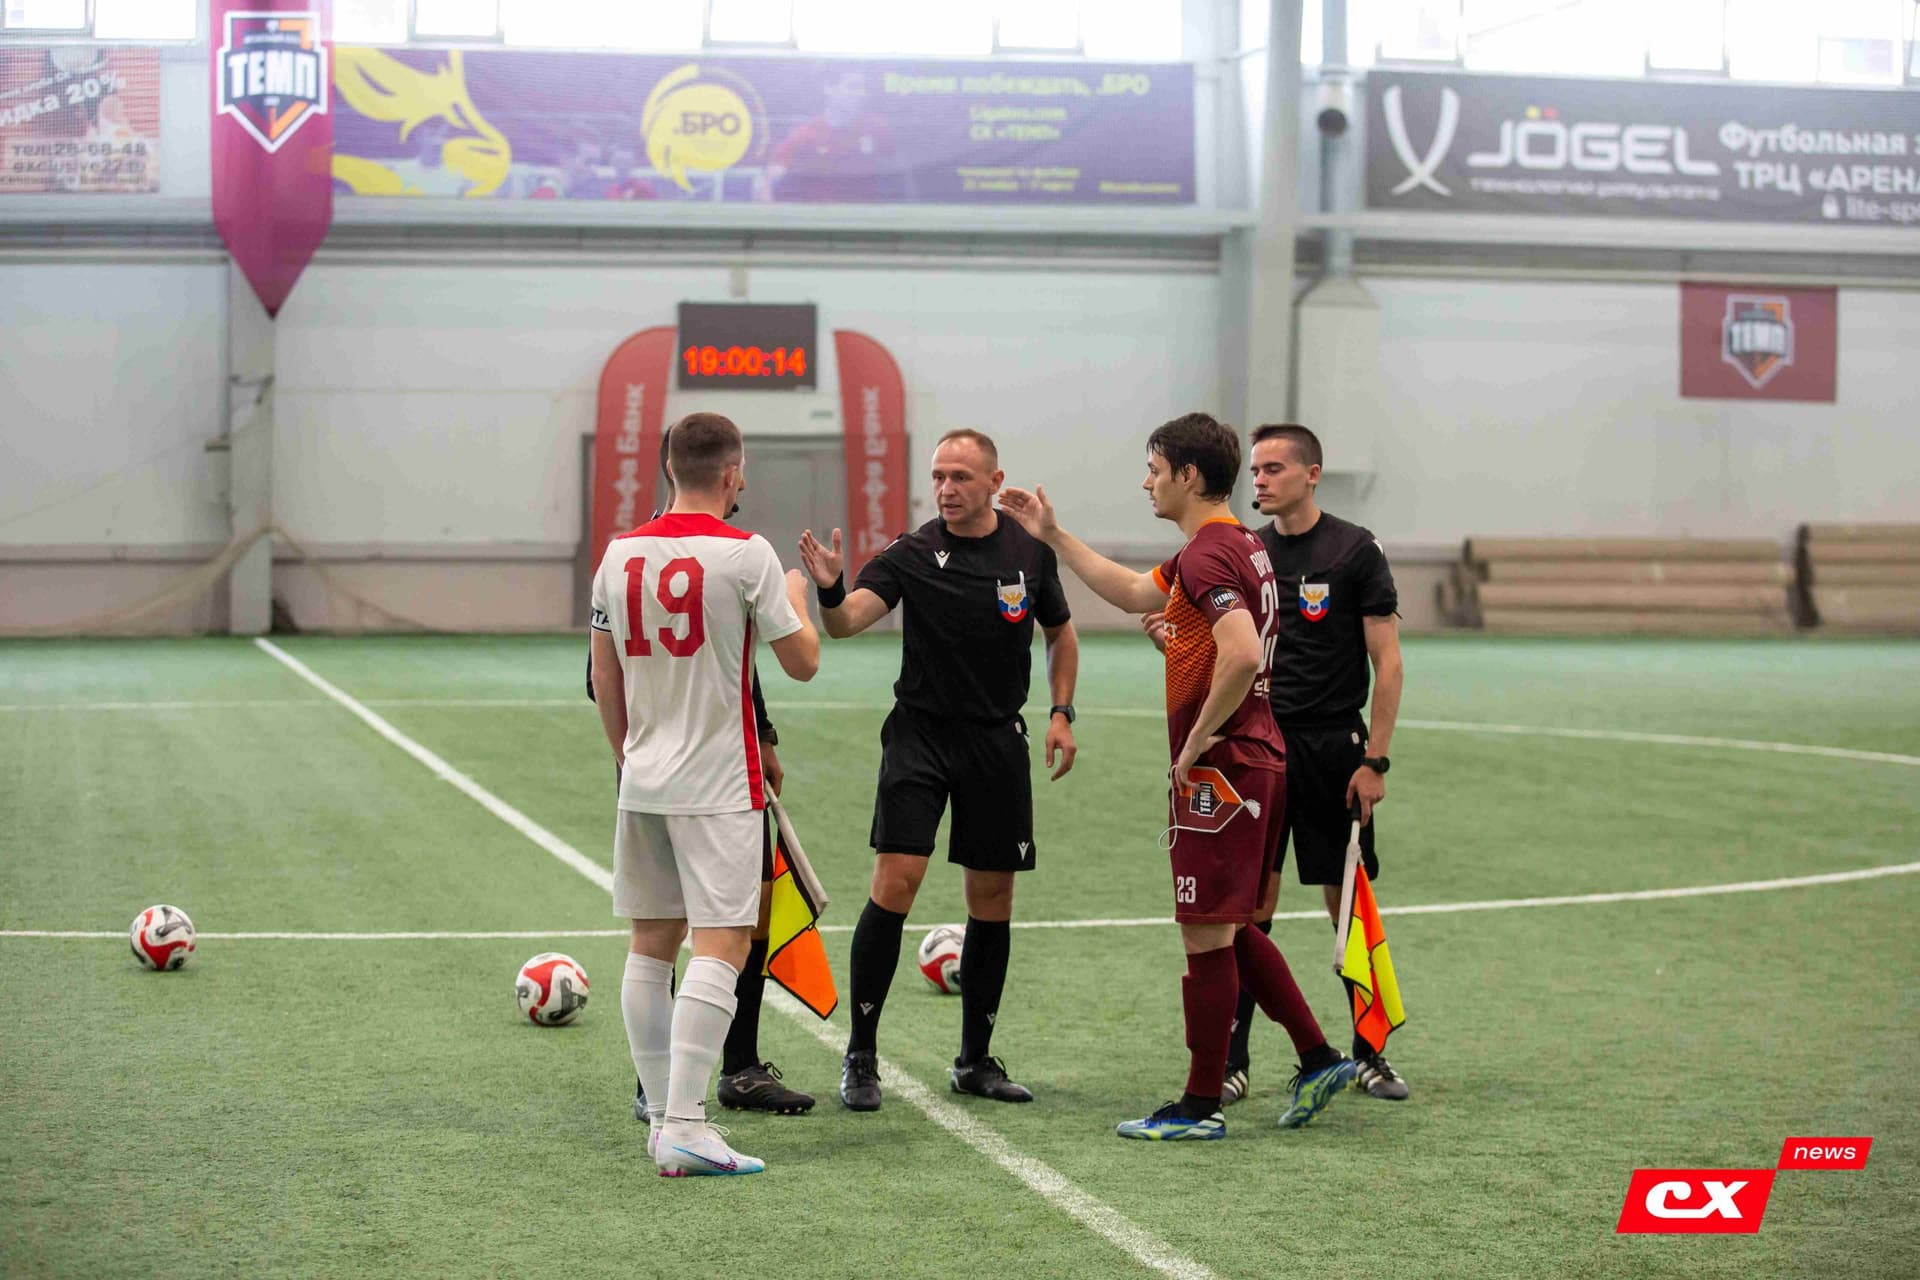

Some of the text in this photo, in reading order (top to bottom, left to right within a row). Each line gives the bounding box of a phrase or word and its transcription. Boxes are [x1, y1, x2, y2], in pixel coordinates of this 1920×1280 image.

[65, 70, 127, 104] 20%
[227, 50, 317, 99] ТЕМП
[1719, 121, 1906, 157] Футбольная
[1733, 161, 1803, 195] ТРЦ
[1731, 322, 1785, 353] ТЕМП
[684, 346, 806, 376] 19:00:14
[616, 383, 645, 453] Банк
[624, 557, 705, 657] 19
[1177, 877, 1197, 904] 23
